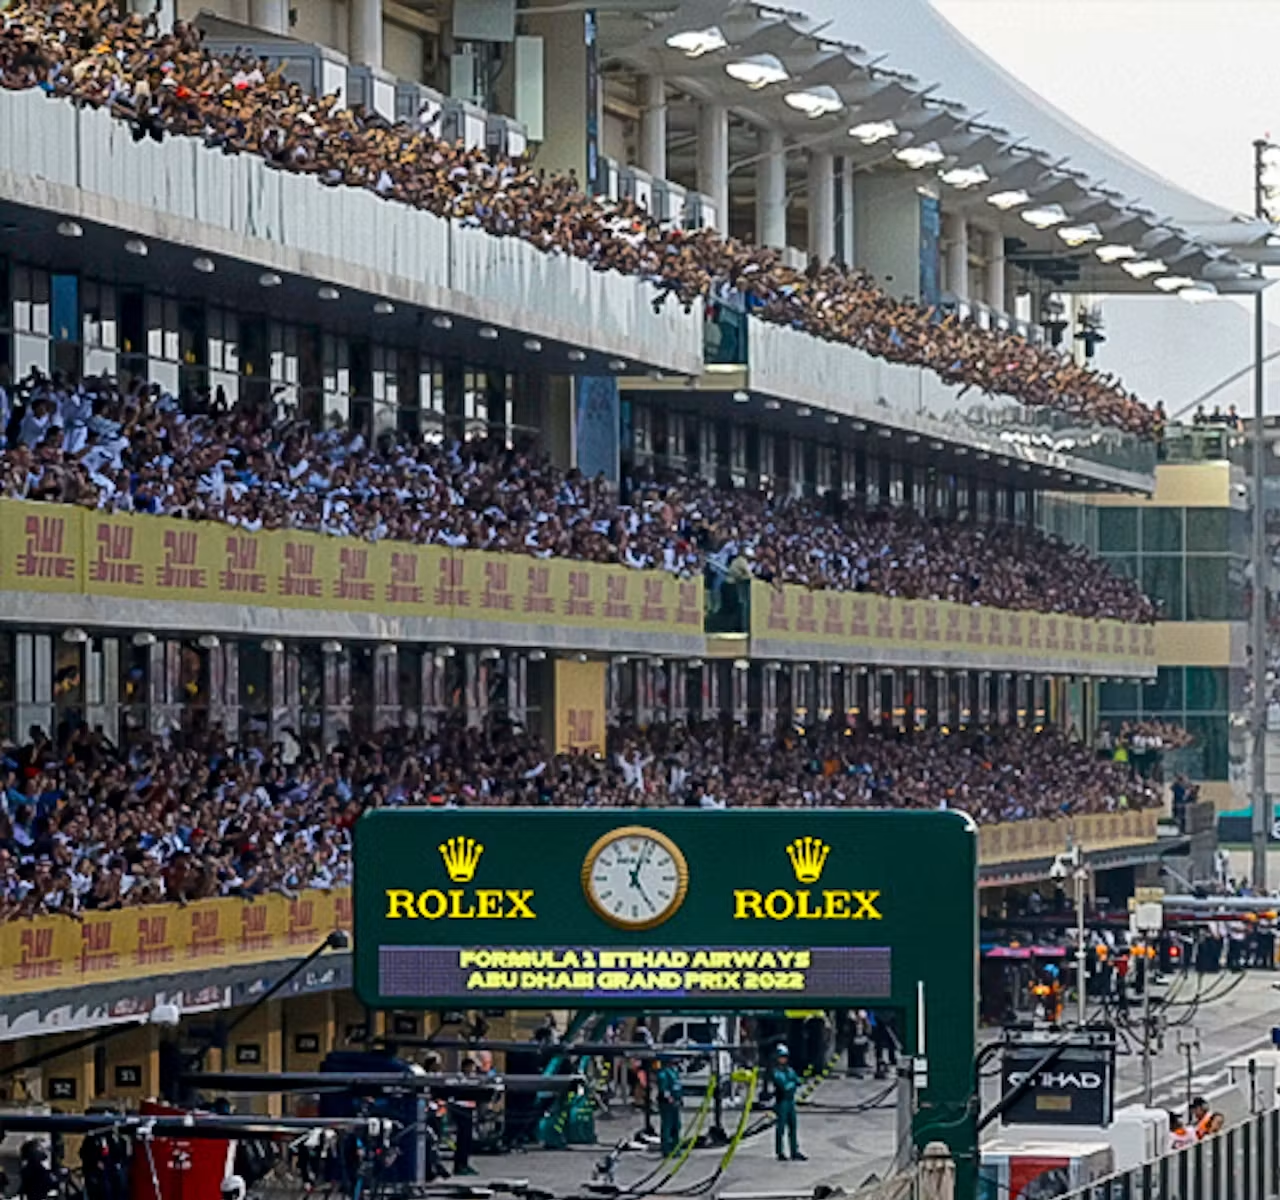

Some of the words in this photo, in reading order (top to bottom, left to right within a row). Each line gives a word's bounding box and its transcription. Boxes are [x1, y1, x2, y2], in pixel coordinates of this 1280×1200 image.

[386, 889, 537, 919] ROLEX
[733, 889, 883, 920] ROLEX
[460, 951, 581, 968] FORMULA
[599, 951, 689, 968] ETIHAD
[691, 951, 811, 968] AIRWAYS
[467, 971, 518, 990] ABU
[520, 971, 595, 990] DHABI
[597, 971, 682, 990] GRAND
[684, 971, 742, 990] PRIX
[743, 971, 806, 990] 2022
